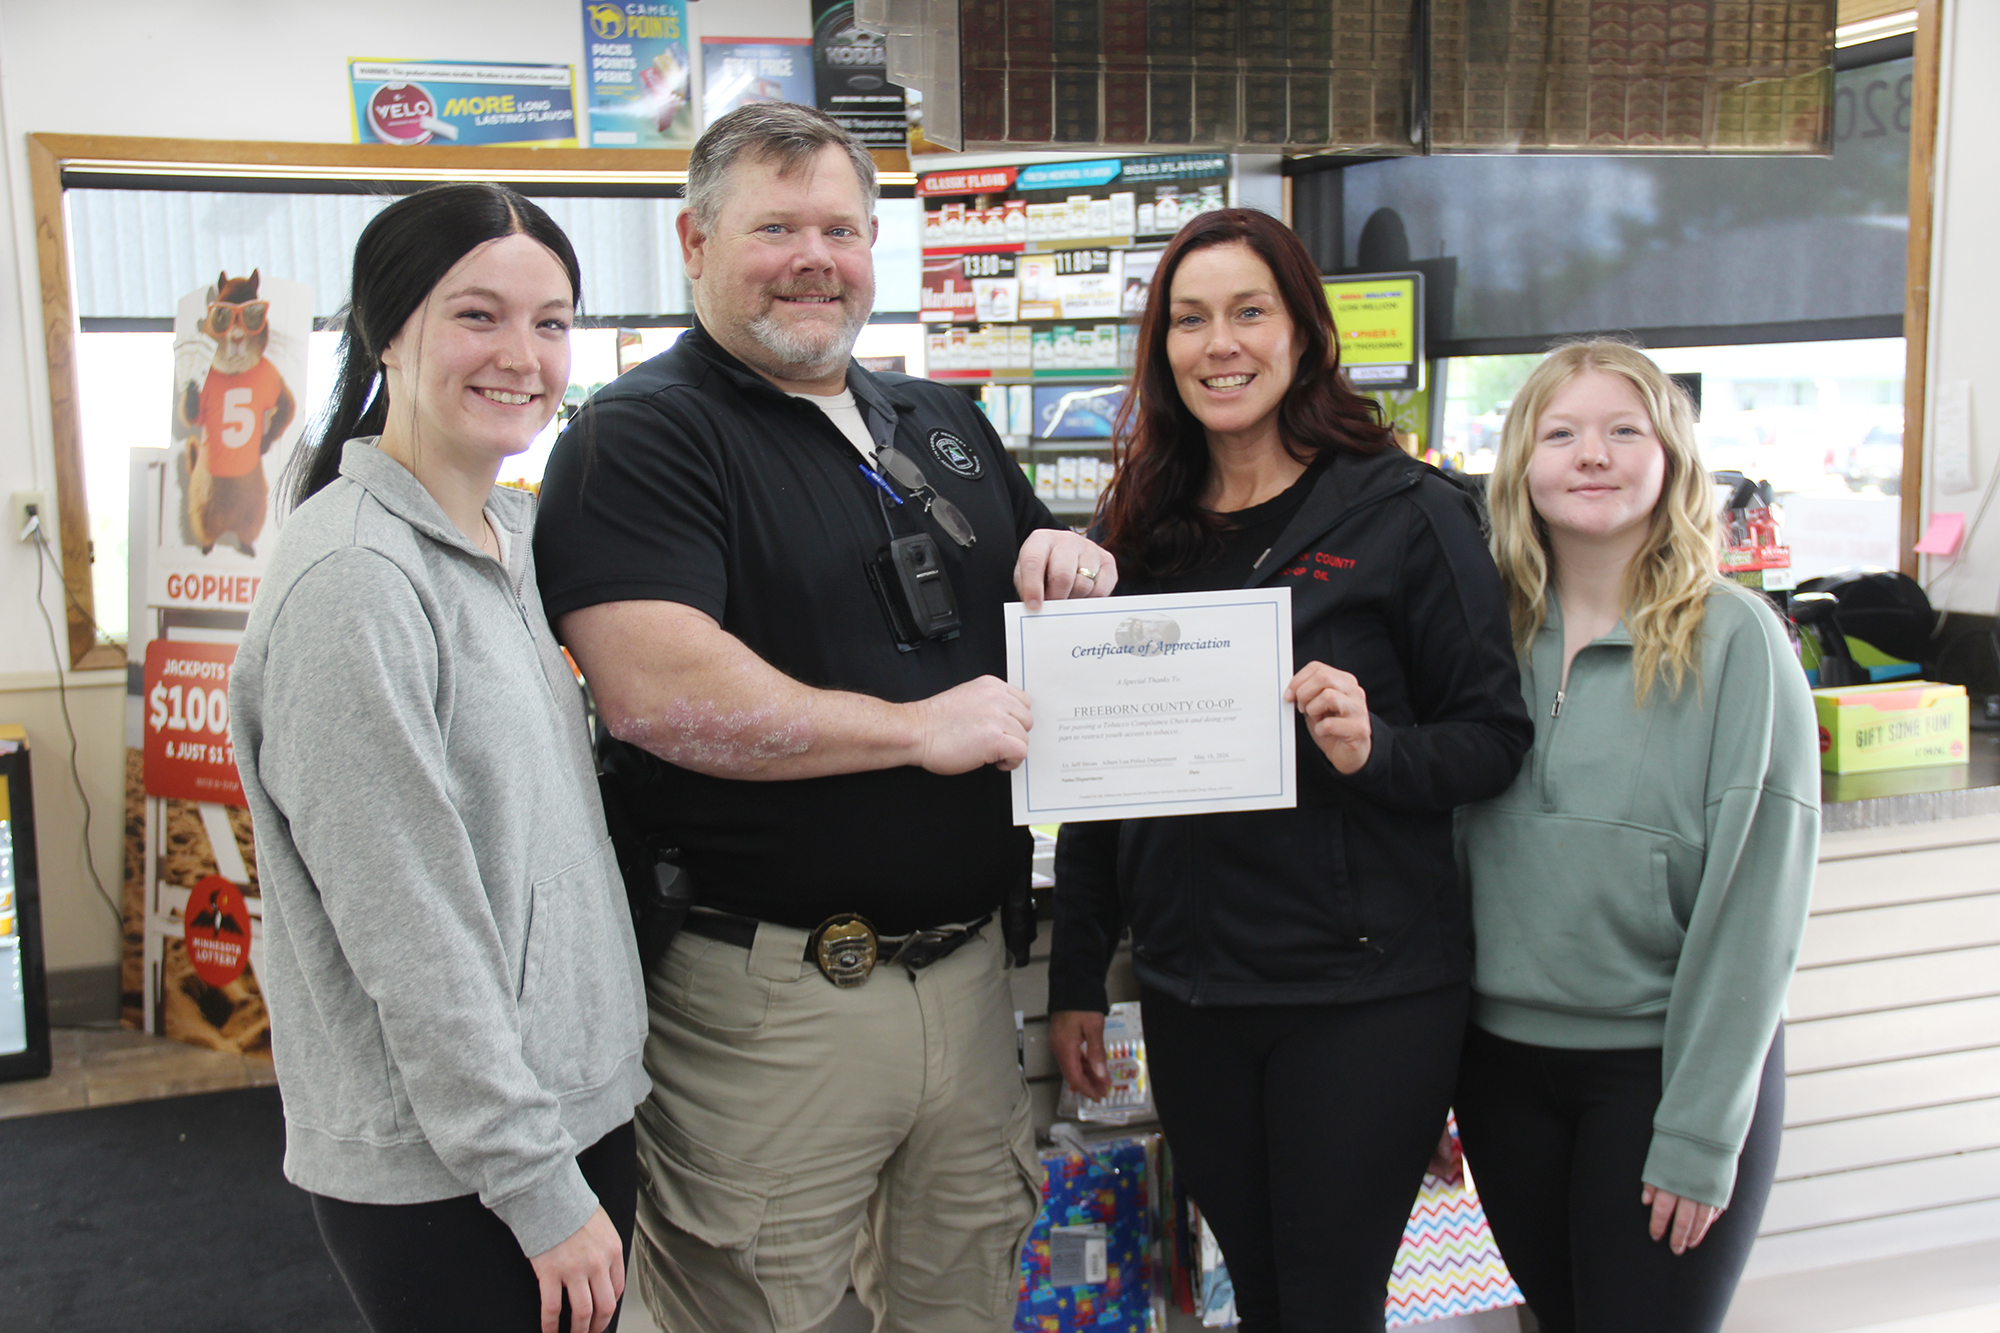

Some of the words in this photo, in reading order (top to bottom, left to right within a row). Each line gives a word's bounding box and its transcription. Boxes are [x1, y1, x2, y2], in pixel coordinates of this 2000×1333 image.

[625, 3, 678, 16] CAMEL
[627, 15, 680, 39] POINTS
[591, 43, 633, 57] PACKS
[825, 46, 886, 65] KODIA
[592, 57, 638, 70] POINTS
[593, 70, 633, 84] PERKS
[374, 100, 431, 119] VELO
[442, 95, 516, 117] MORE
[516, 100, 552, 113] LONG
[474, 112, 526, 127] LASTING
[526, 109, 574, 123] FLAVOR
[1122, 163, 1159, 176] BOLD
[924, 176, 966, 191] CLASSIC
[921, 279, 974, 309] Marlboro
[222, 387, 257, 449] 5
[1315, 552, 1357, 569] COUNTY
[1071, 642, 1135, 660] Certificate
[1137, 640, 1152, 657] of
[1152, 637, 1231, 657] Appreciation
[163, 659, 226, 680] JACKPOTS
[1123, 677, 1146, 687] Special
[1148, 676, 1171, 685] Thanks
[1073, 704, 1140, 717] FREEBORN
[1142, 700, 1194, 713] COUNTY
[1196, 698, 1236, 710] CO-OP
[1058, 724, 1070, 732] For
[1071, 723, 1096, 732] passing
[1103, 721, 1130, 729] Tobacco
[1131, 718, 1168, 728] Compliance
[1169, 716, 1189, 725] Check
[1190, 716, 1202, 724] and
[1203, 715, 1222, 723] doing
[1058, 734, 1072, 743] part
[1081, 732, 1104, 740] restrict
[1105, 731, 1123, 739] youth
[1856, 726, 1882, 748] GIFT
[1888, 719, 1920, 741] SOME
[165, 740, 175, 758] &
[176, 742, 208, 762] JUST
[208, 745, 225, 765] $1
[192, 936, 242, 956] MINNESOTA
[195, 949, 238, 968] LOTTERY
